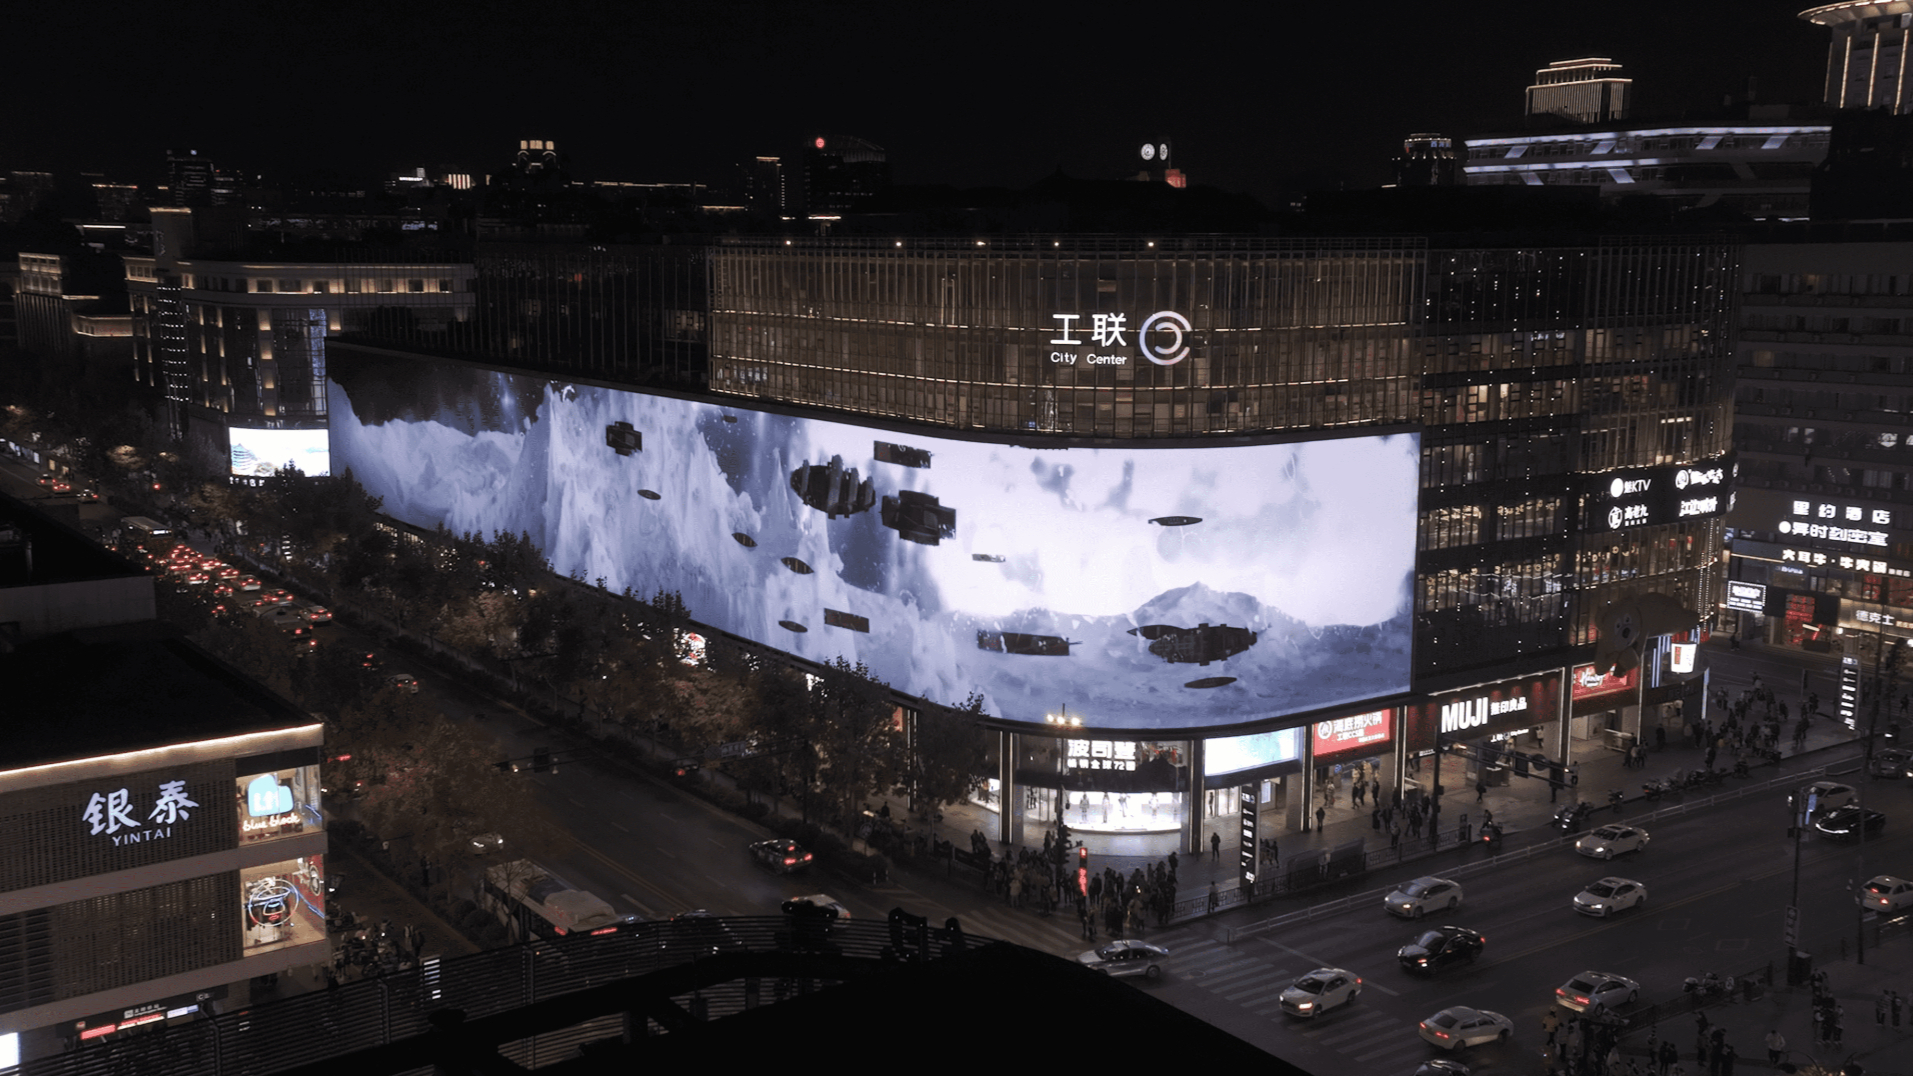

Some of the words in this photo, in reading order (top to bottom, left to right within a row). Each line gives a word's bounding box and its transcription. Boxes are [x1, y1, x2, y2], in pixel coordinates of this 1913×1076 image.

[1050, 312, 1127, 348] 工联
[1050, 352, 1078, 366] City
[1086, 353, 1128, 366] Center
[1793, 500, 1891, 525] 里约酒店
[1856, 609, 1896, 627] 德克士
[1441, 697, 1489, 734] MUJI
[1067, 739, 1136, 760] 波司登
[82, 780, 200, 836] 银泰
[112, 826, 172, 847] YINTAI
